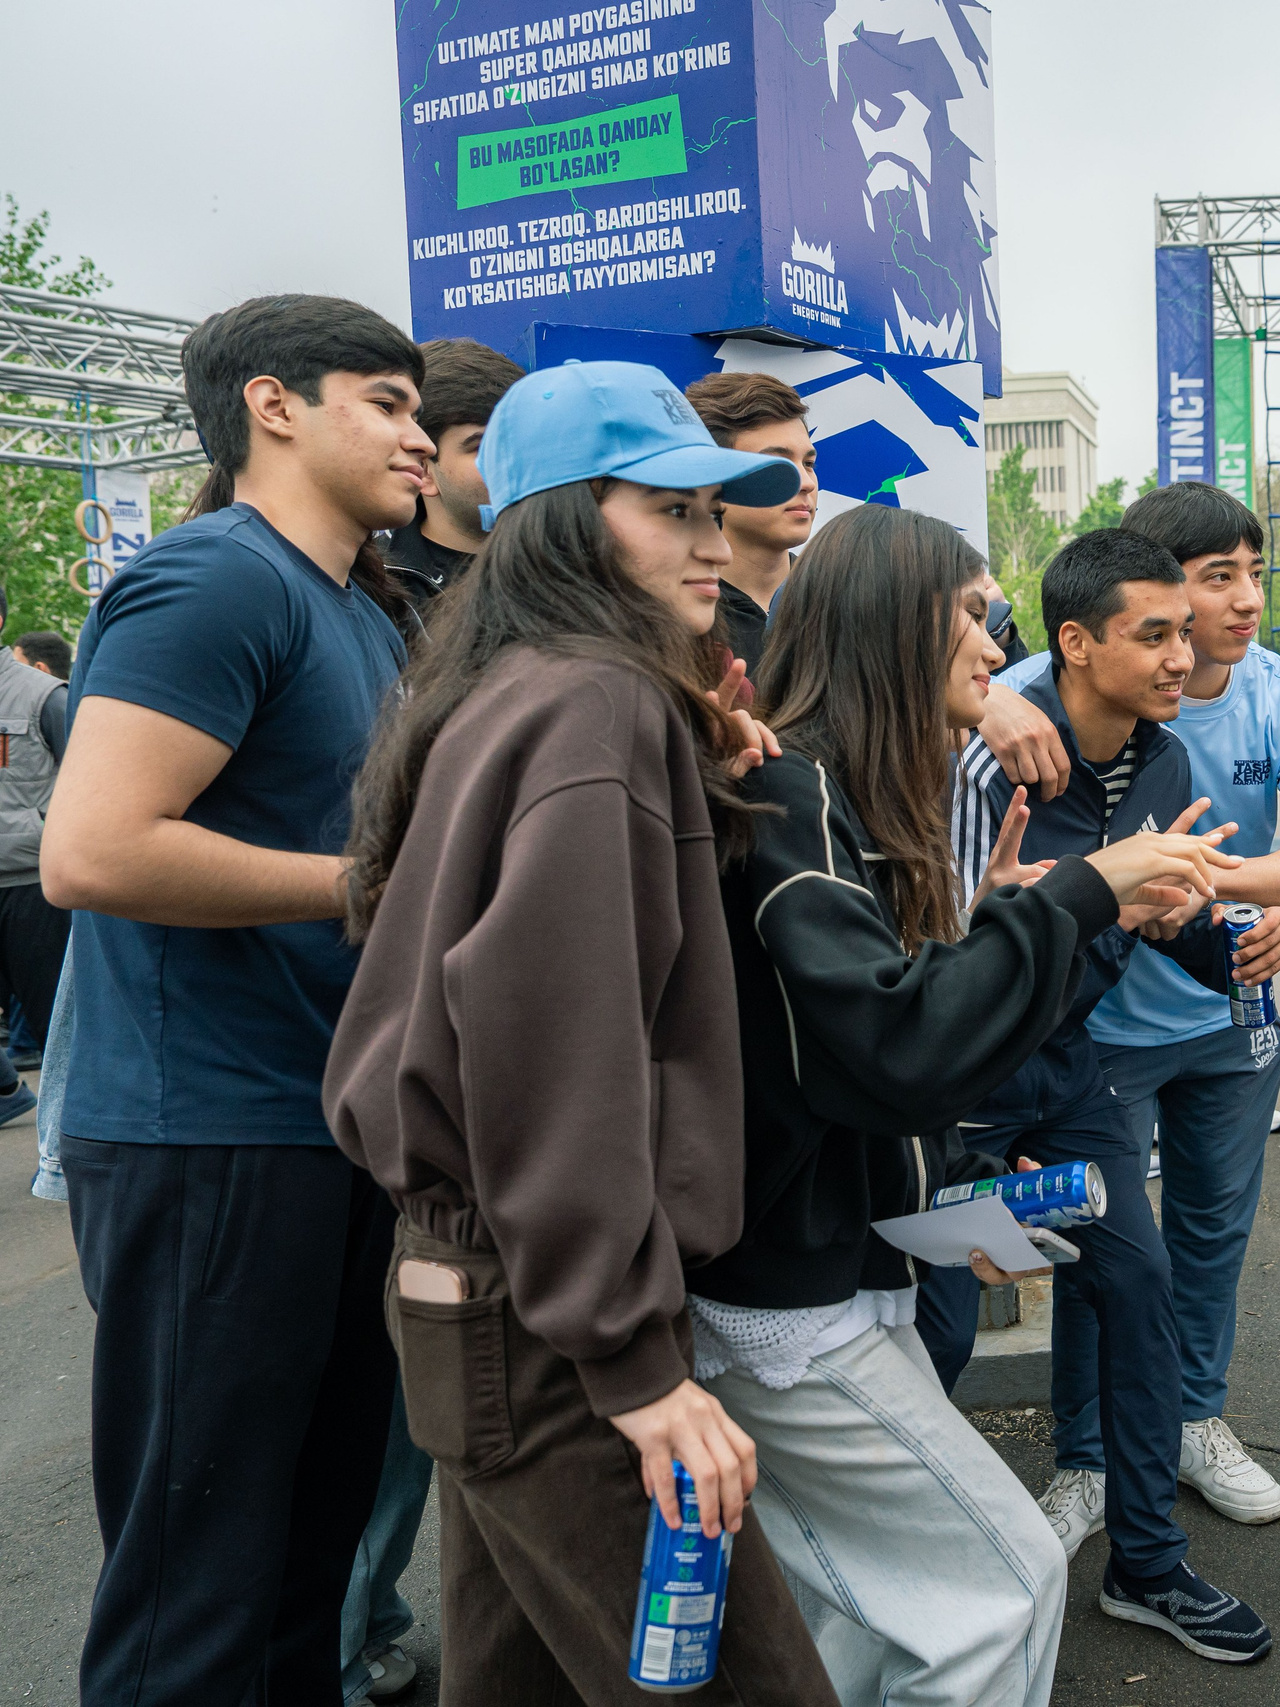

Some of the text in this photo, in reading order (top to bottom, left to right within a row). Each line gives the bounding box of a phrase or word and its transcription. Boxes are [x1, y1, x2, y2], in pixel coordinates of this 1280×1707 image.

[438, 27, 520, 64] ULTIMATE
[525, 17, 565, 46] MAN
[480, 28, 651, 84] SUPER QAHRAMONI
[413, 42, 731, 125] SIFATIDA O'ZINGIZNI SINAB KO'RING
[469, 112, 673, 169] BU MASOFADA QANDAY
[519, 150, 620, 188] BO'LASAN?
[413, 188, 747, 260] KUCHLIROQ. TEZROQ. BARDOSHLIROQ.
[443, 250, 716, 310] KO'RSATISHGA TAYYORMISAN?
[469, 226, 685, 279] O'ZINGNI BOSHQALARGA
[781, 261, 849, 315] GORILLA
[792, 303, 842, 329] ENERGY DRINK
[1170, 372, 1204, 482] TINCT
[1249, 1024, 1279, 1055] 1231
